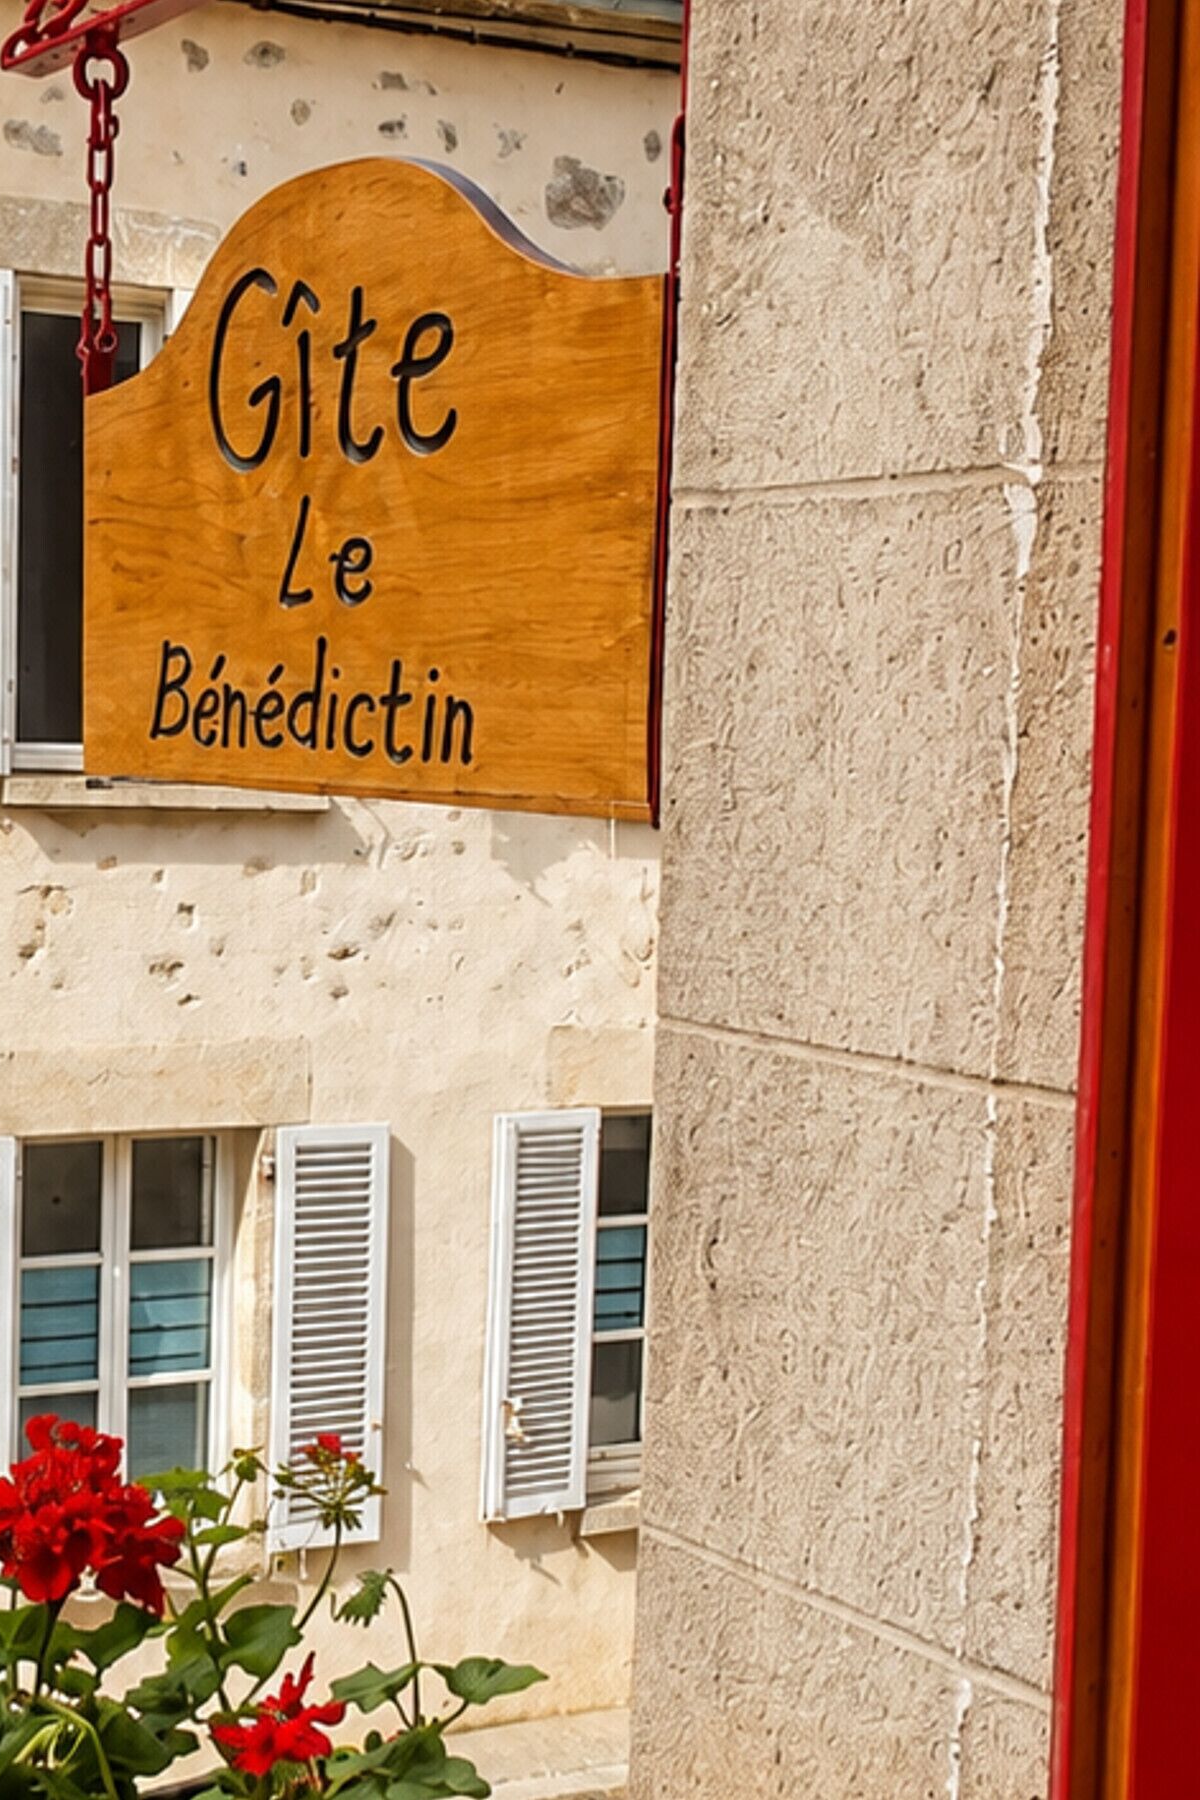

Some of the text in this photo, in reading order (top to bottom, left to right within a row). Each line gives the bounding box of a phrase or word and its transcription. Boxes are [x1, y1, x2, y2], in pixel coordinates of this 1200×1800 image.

[208, 267, 458, 472] Gîte
[279, 494, 374, 608] Le
[149, 635, 475, 766] Bénédictin
